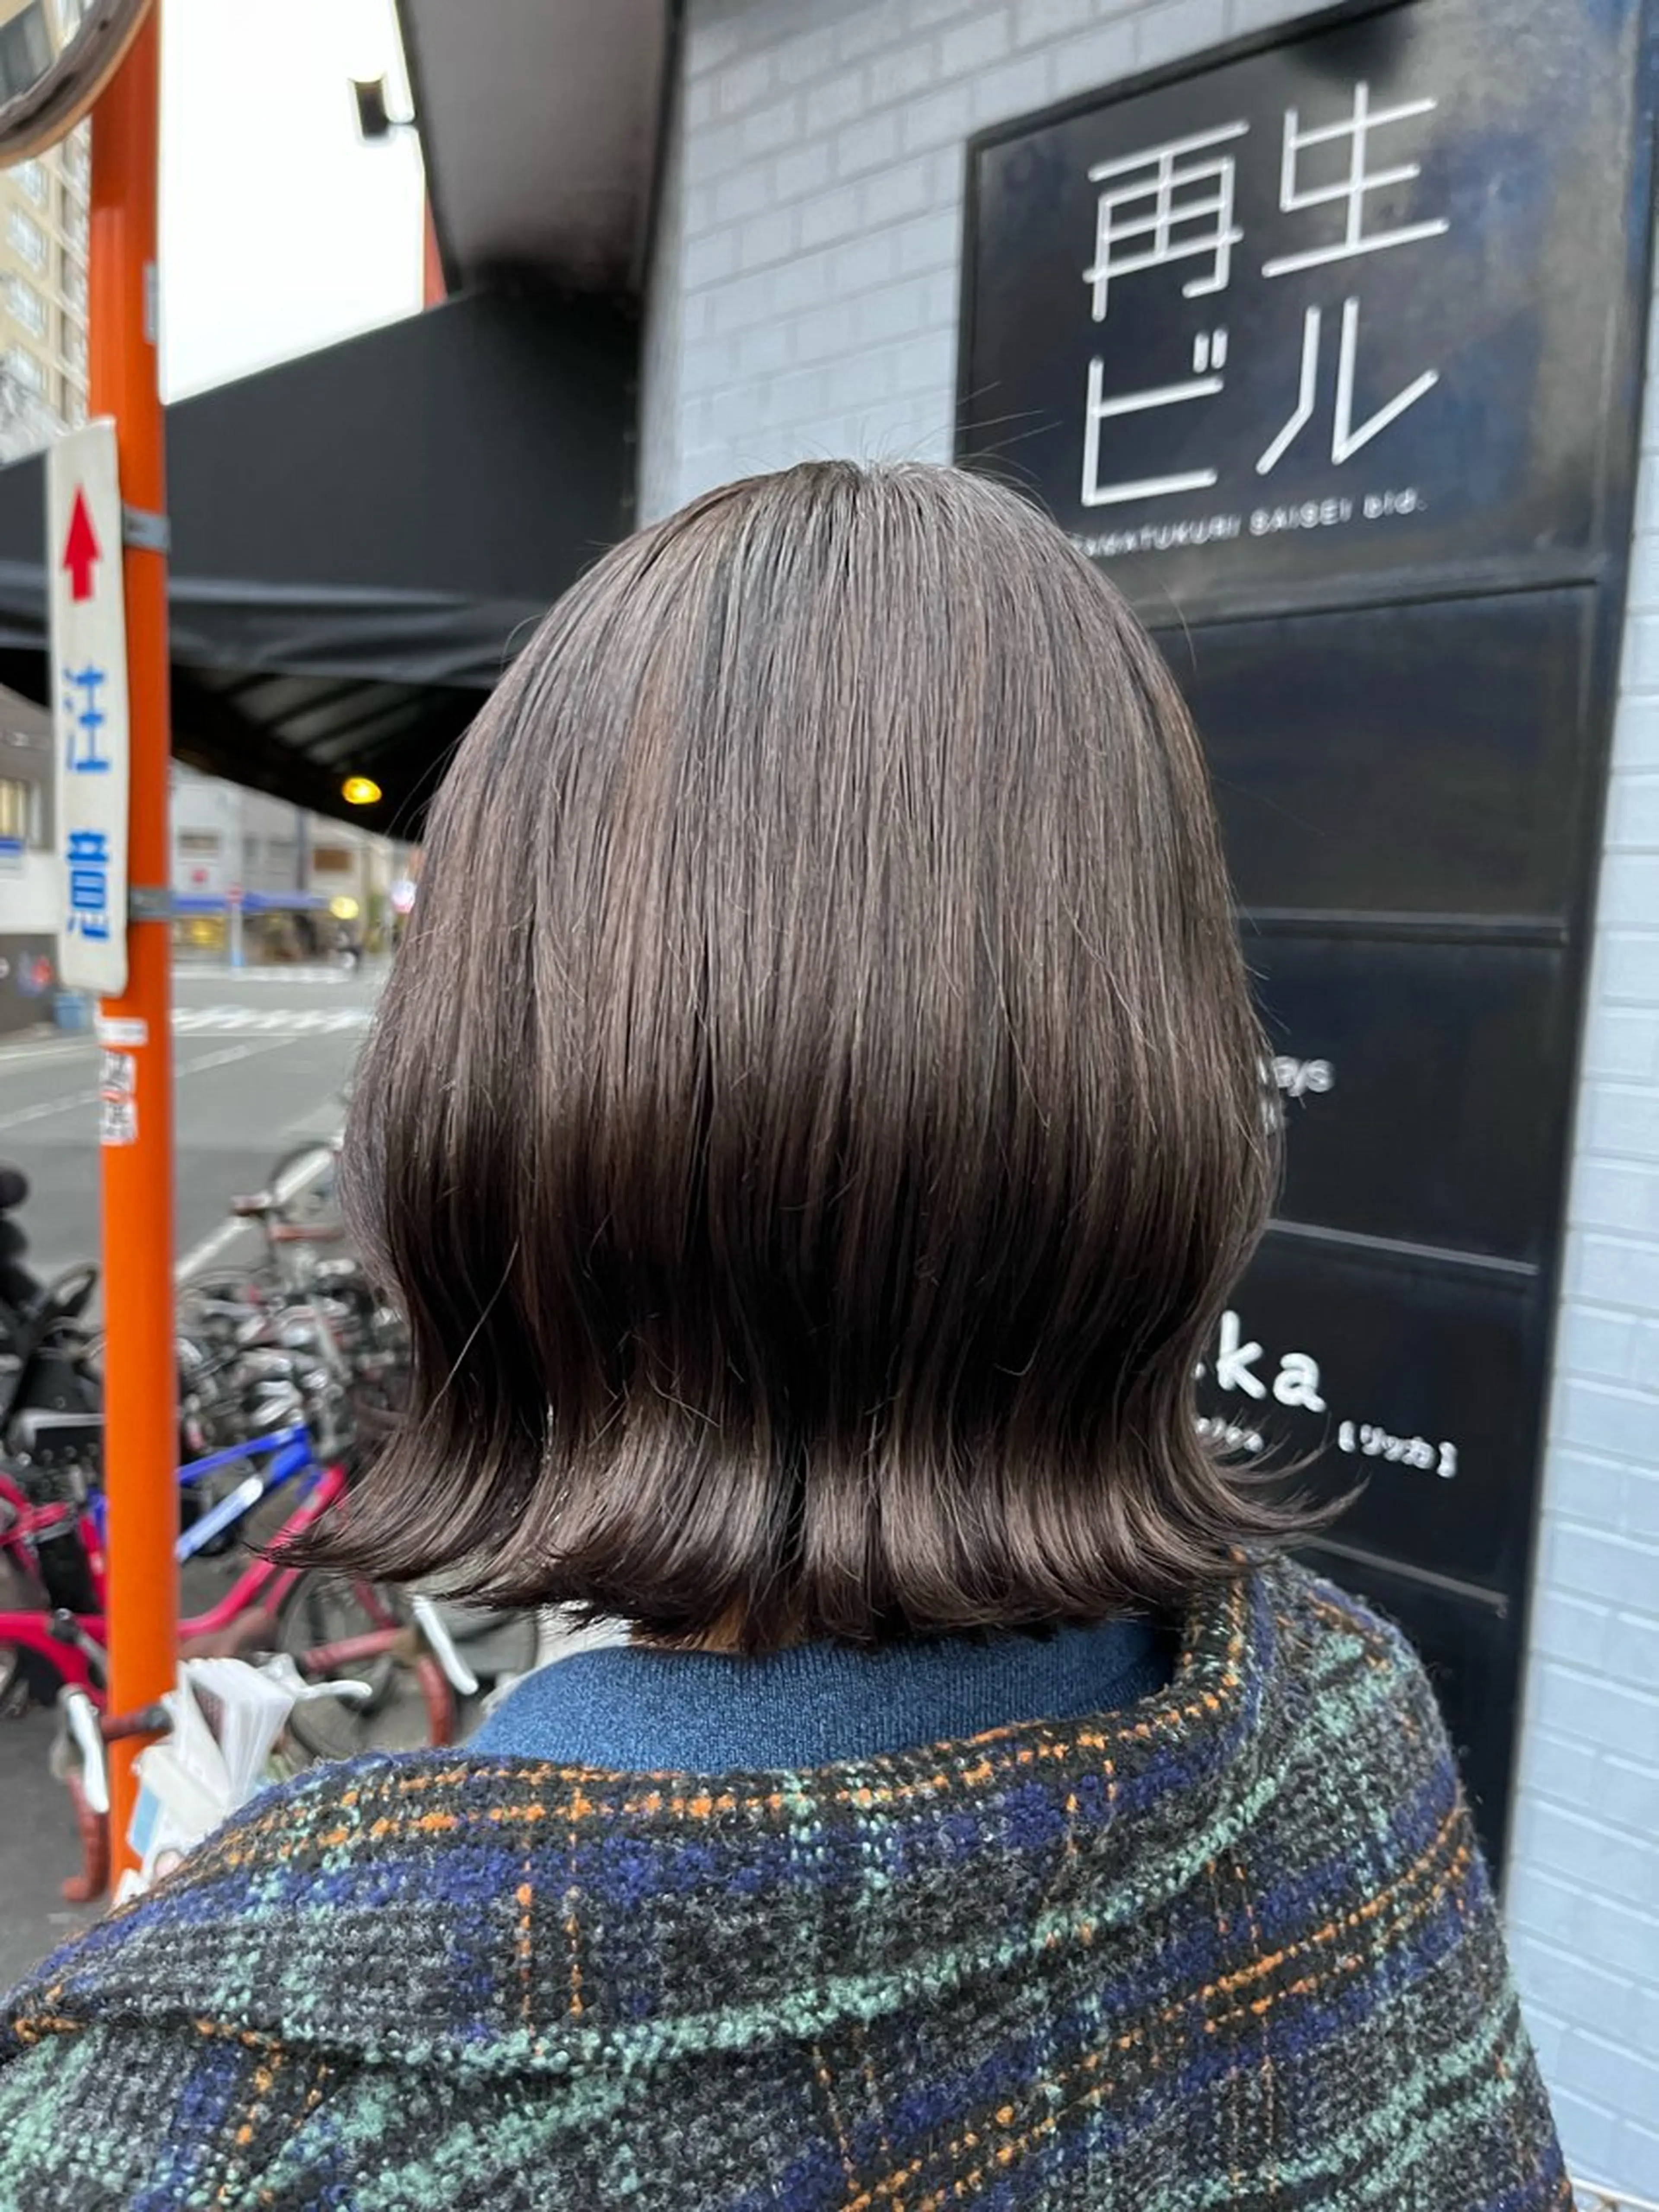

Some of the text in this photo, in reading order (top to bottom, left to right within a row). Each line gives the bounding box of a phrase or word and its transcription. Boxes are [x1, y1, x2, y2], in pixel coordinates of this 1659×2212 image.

[1082, 82, 1449, 321] 再生
[1081, 296, 1439, 507] ビル
[1249, 498, 1353, 535] SAISEI
[63, 664, 110, 939] 注意
[1192, 1310, 1327, 1413] ka
